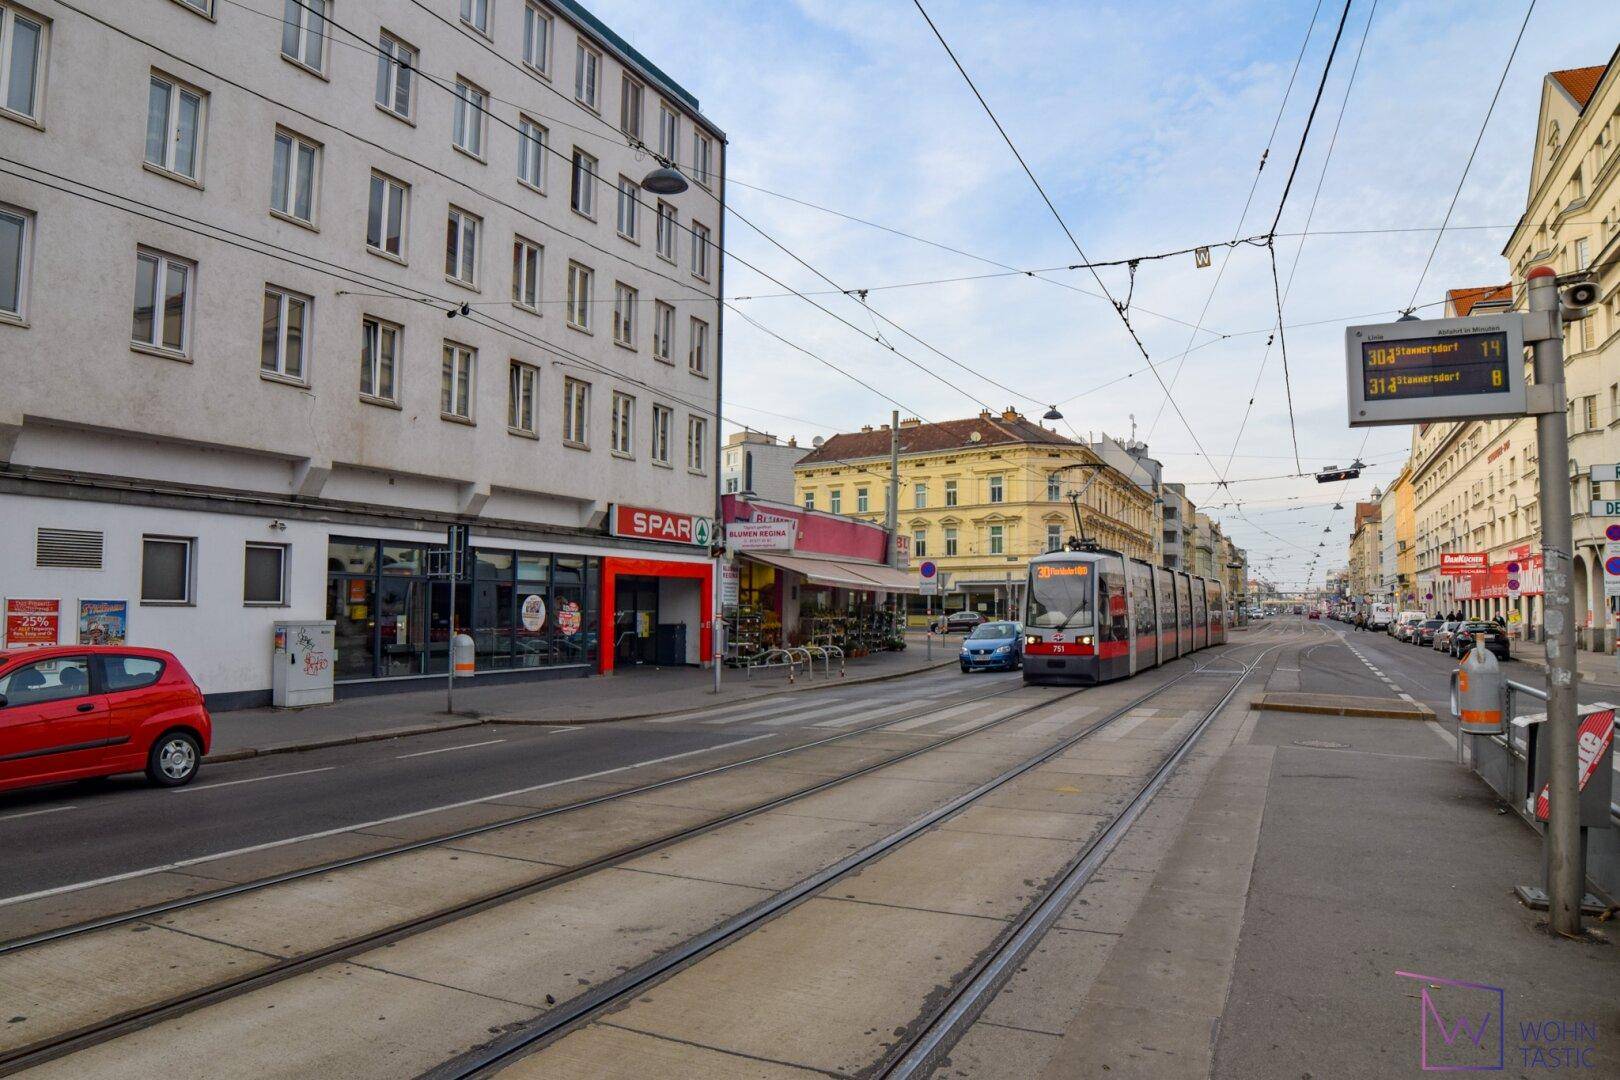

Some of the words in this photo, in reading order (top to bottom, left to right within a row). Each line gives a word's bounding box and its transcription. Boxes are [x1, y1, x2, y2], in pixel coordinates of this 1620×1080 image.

[1368, 349, 1386, 366] 30
[1480, 340, 1500, 357] 14
[1369, 377, 1385, 395] 31
[1492, 369, 1503, 387] 8
[633, 512, 691, 539] SPAR
[16, 616, 49, 627] -25%
[1053, 645, 1065, 653] 751
